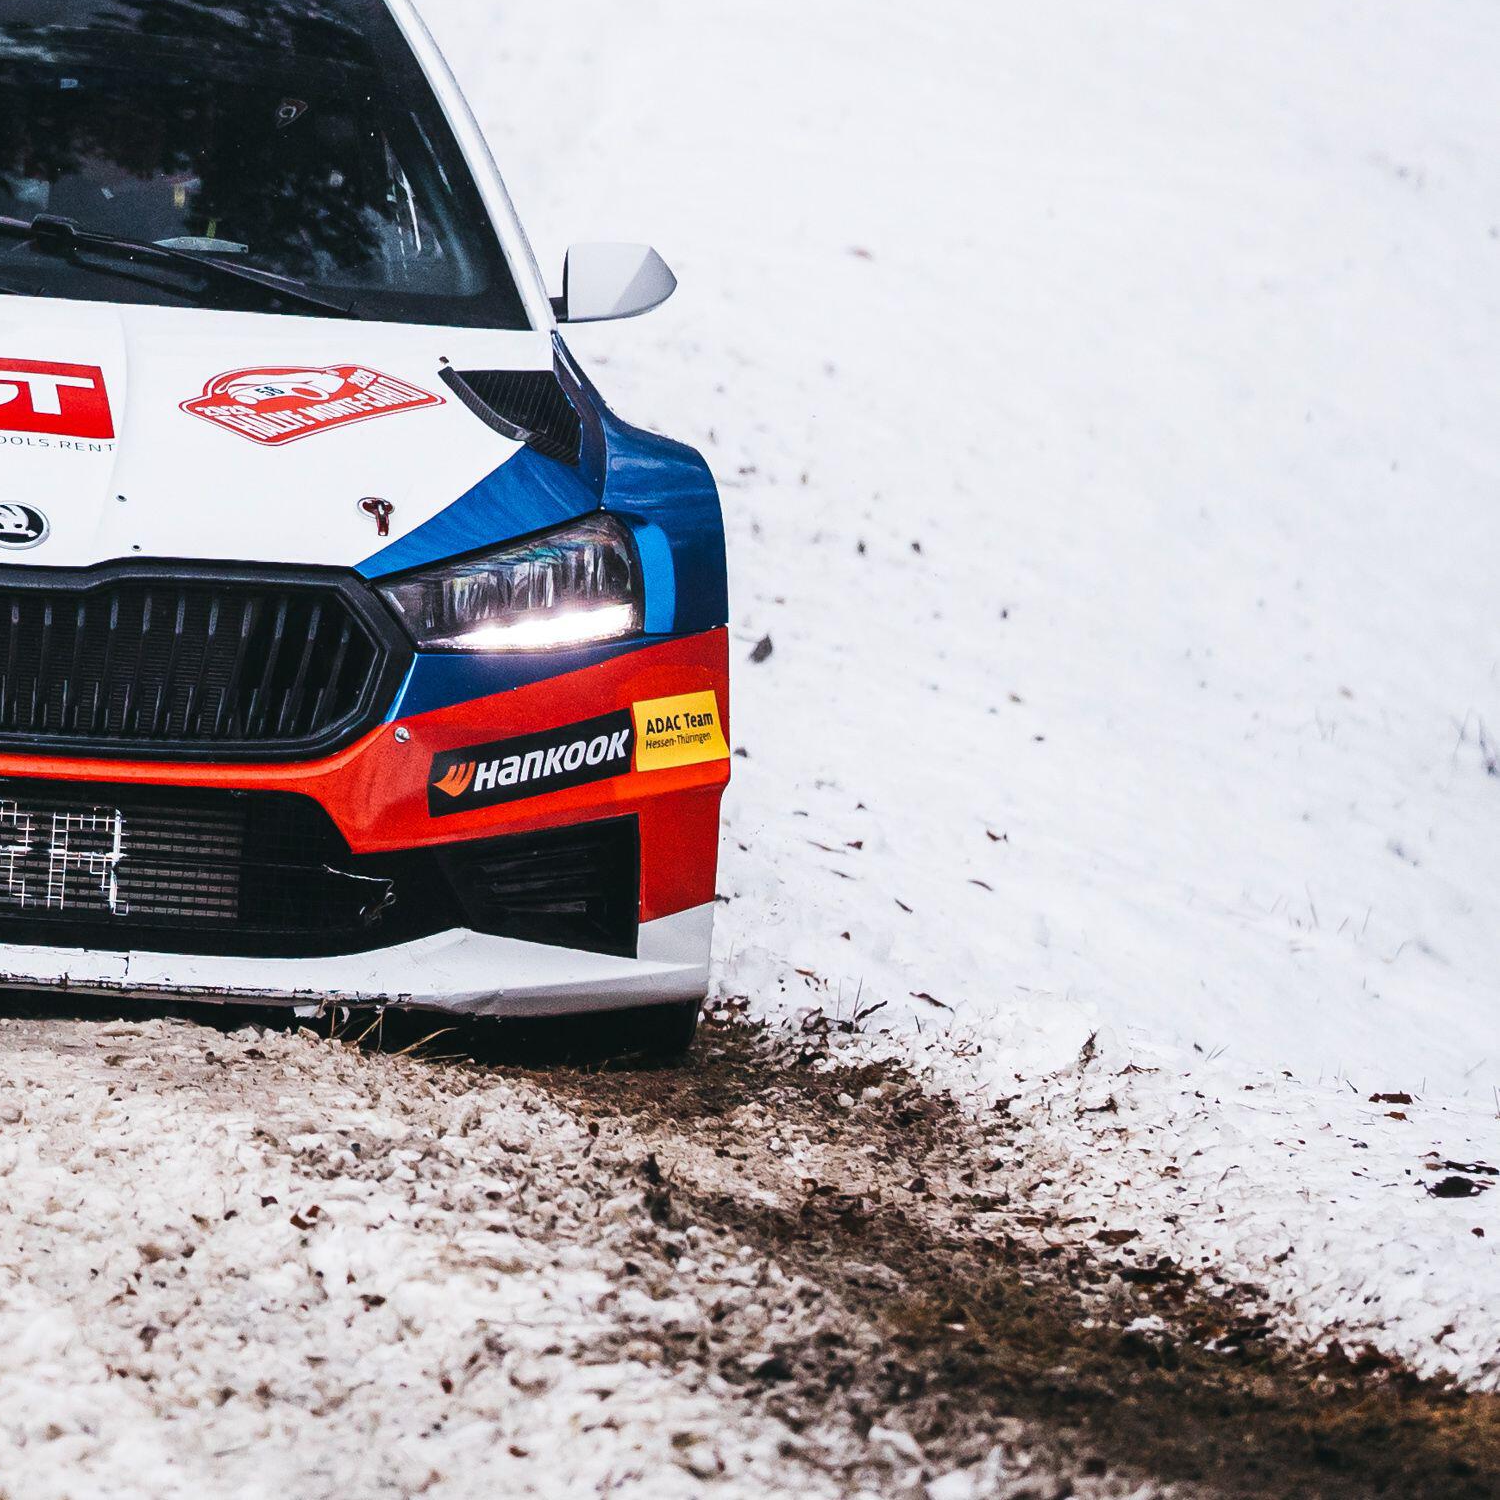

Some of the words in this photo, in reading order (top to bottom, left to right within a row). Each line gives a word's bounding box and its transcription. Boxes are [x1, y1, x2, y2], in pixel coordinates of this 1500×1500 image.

[213, 409, 317, 440] RALLYE
[645, 714, 682, 736] ADAC
[683, 712, 714, 729] Team
[645, 731, 712, 750] Hessen-Thüringen
